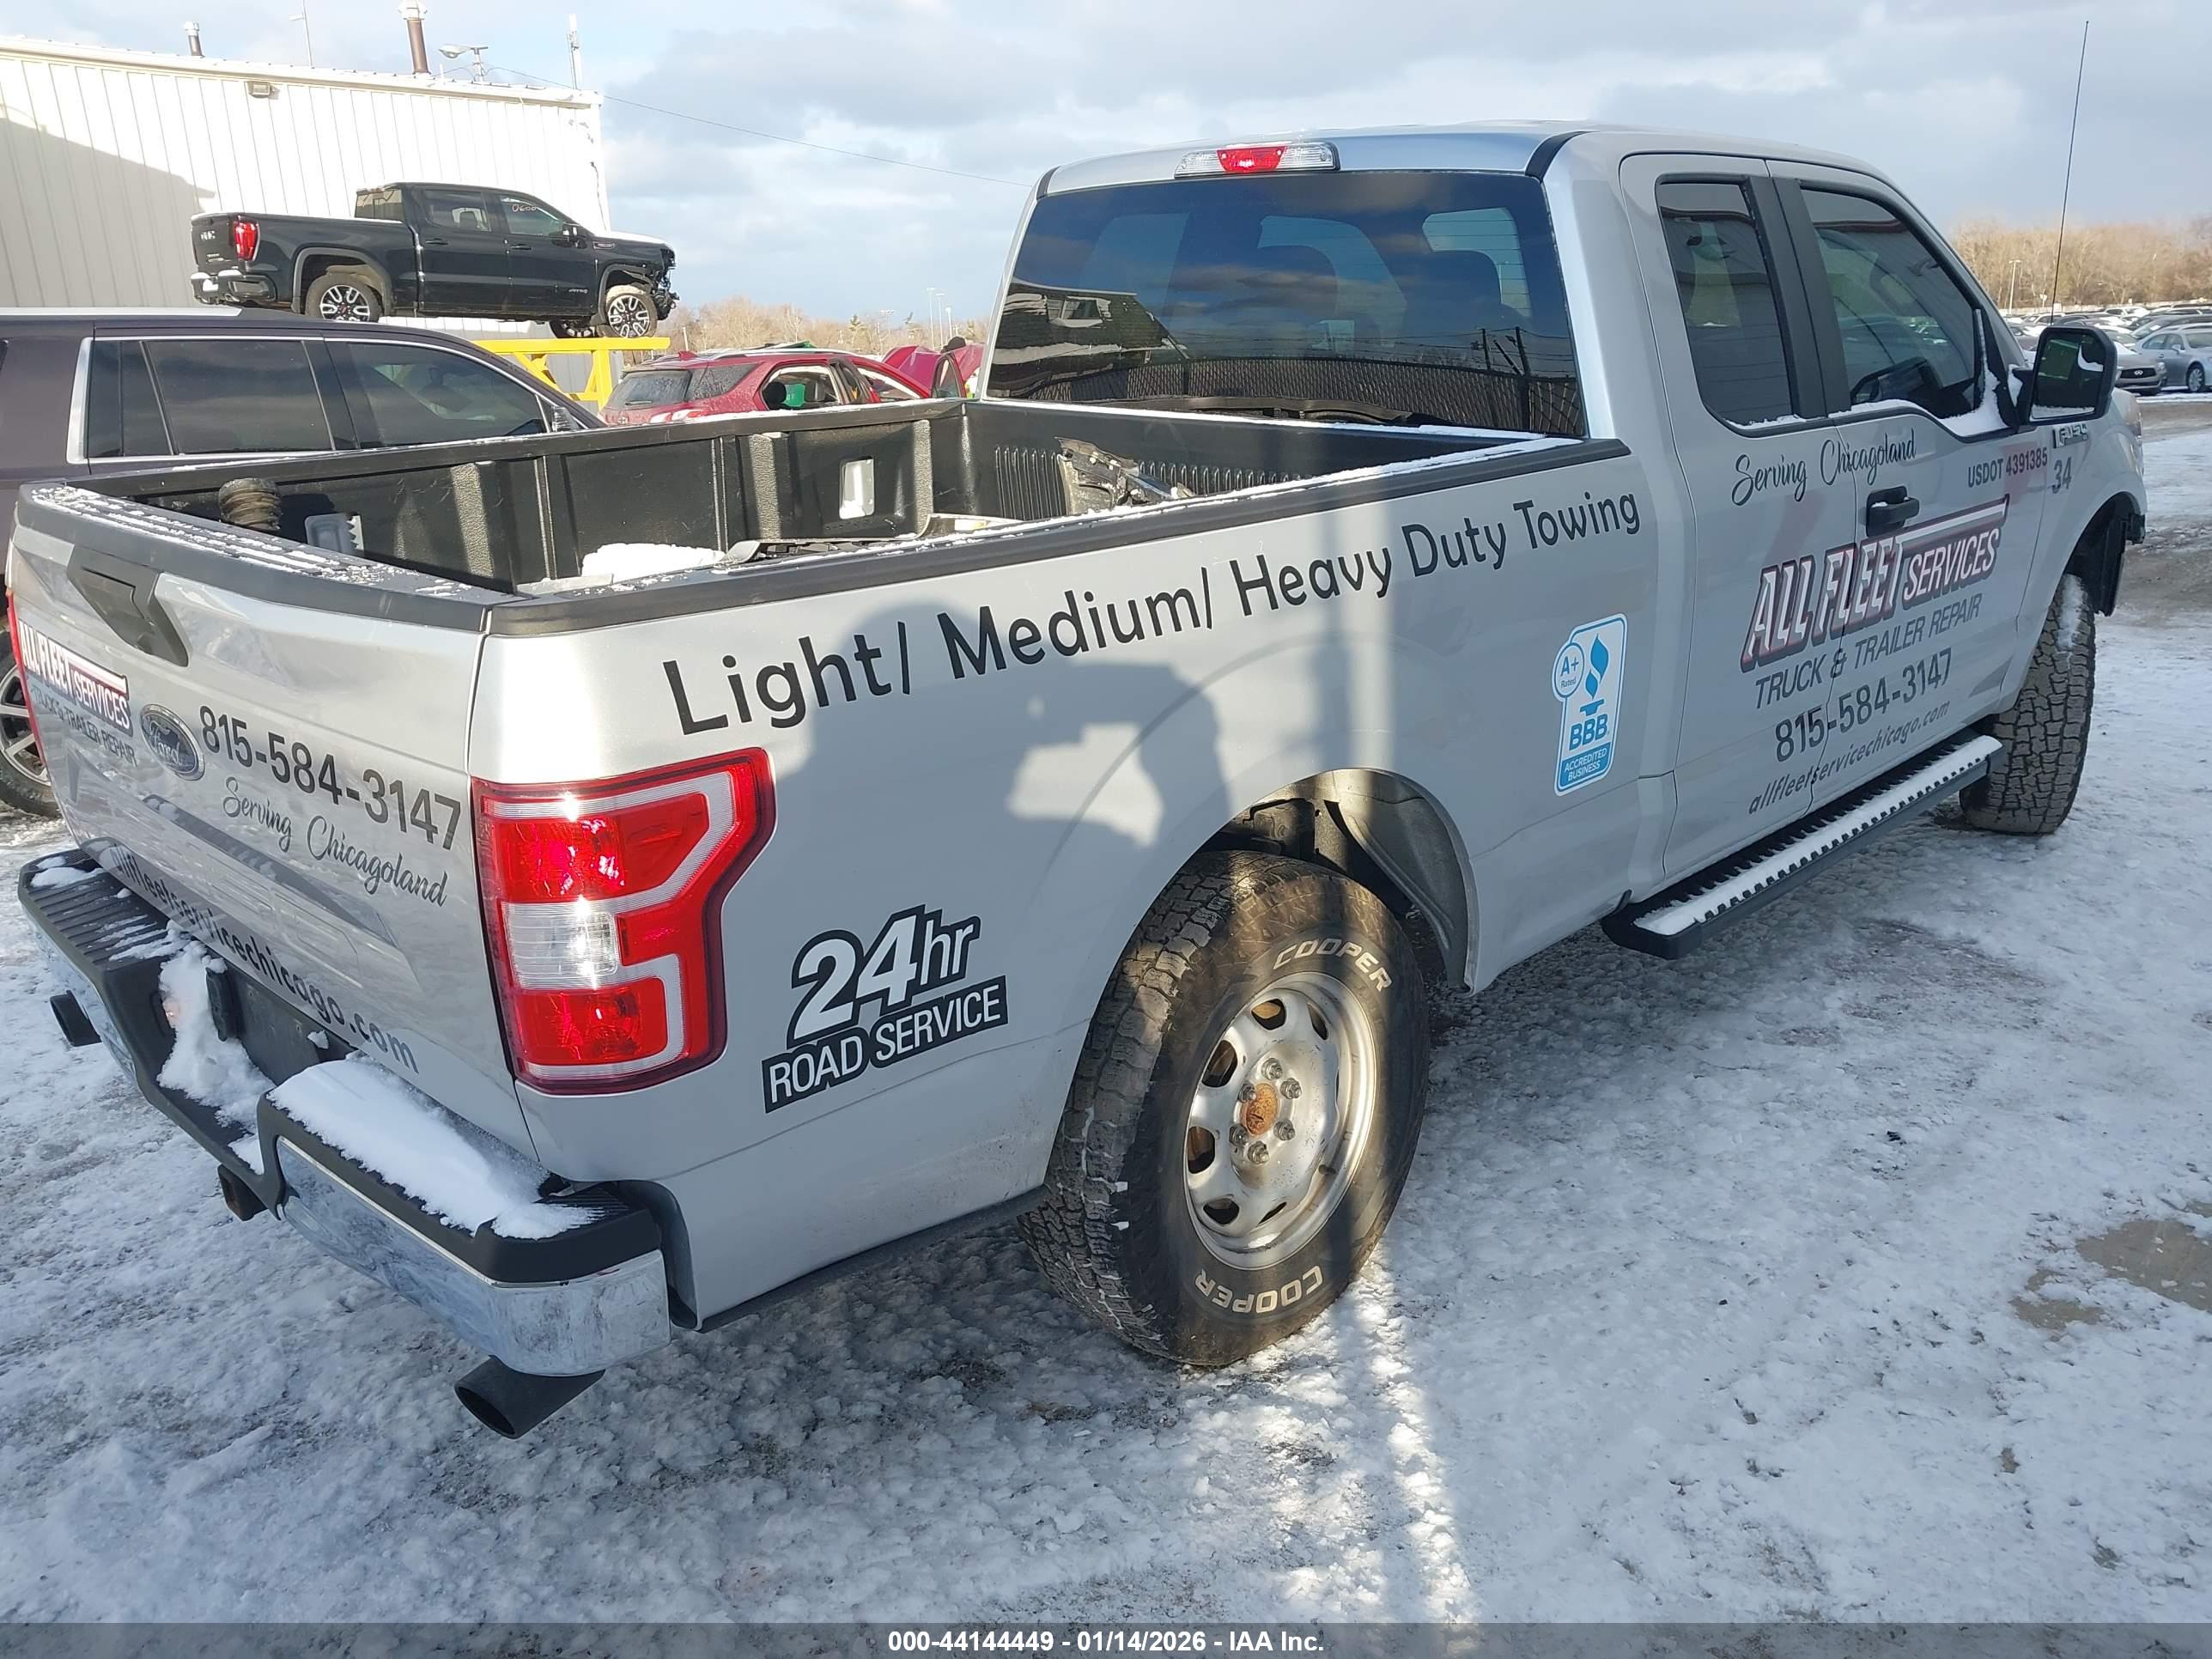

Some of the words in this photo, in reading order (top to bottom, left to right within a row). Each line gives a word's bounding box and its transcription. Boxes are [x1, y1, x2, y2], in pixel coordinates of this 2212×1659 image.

[1731, 453, 1808, 507] Serving
[1820, 428, 1917, 486] Chicagoland
[1968, 459, 2003, 488] USDOT
[2006, 447, 2048, 477] 4391385
[2051, 456, 2072, 494] 34
[662, 622, 912, 736] Light/
[937, 567, 1213, 679] Medium/
[1230, 546, 1392, 617] Heavy
[1401, 517, 1506, 577] Duty
[1513, 491, 1641, 550] Towing
[1743, 557, 1814, 667] ALL
[1904, 527, 2000, 602] SERVICES
[19, 621, 42, 677] ALL
[74, 669, 131, 730] SERVICES
[1559, 656, 1579, 677] A+
[1560, 678, 1577, 688] Rated
[1755, 653, 1827, 709] TRUCK
[1830, 647, 1847, 678] &
[1855, 616, 1926, 669] TRAILER
[1929, 592, 1983, 638] REPAIR
[65, 709, 101, 744] TRAILER
[101, 731, 138, 767] REPAIR
[1569, 714, 1608, 750] BBB
[1775, 647, 1953, 763] 815-584-3147
[149, 720, 180, 765] Ford
[1565, 746, 1607, 773] ACCREDITED
[1567, 760, 1601, 781] BUSINESS
[1748, 701, 1951, 815] allfleetservicechicago.com
[200, 706, 461, 850] 815-584-3147
[222, 776, 294, 853] Serving
[307, 816, 450, 908] Chicagoland
[793, 914, 975, 1040] 24hr
[1273, 938, 1392, 993] COOPER
[769, 1036, 863, 1104] ROAD
[876, 984, 1001, 1060] SERVICE
[1194, 1265, 1323, 1314] COOPER
